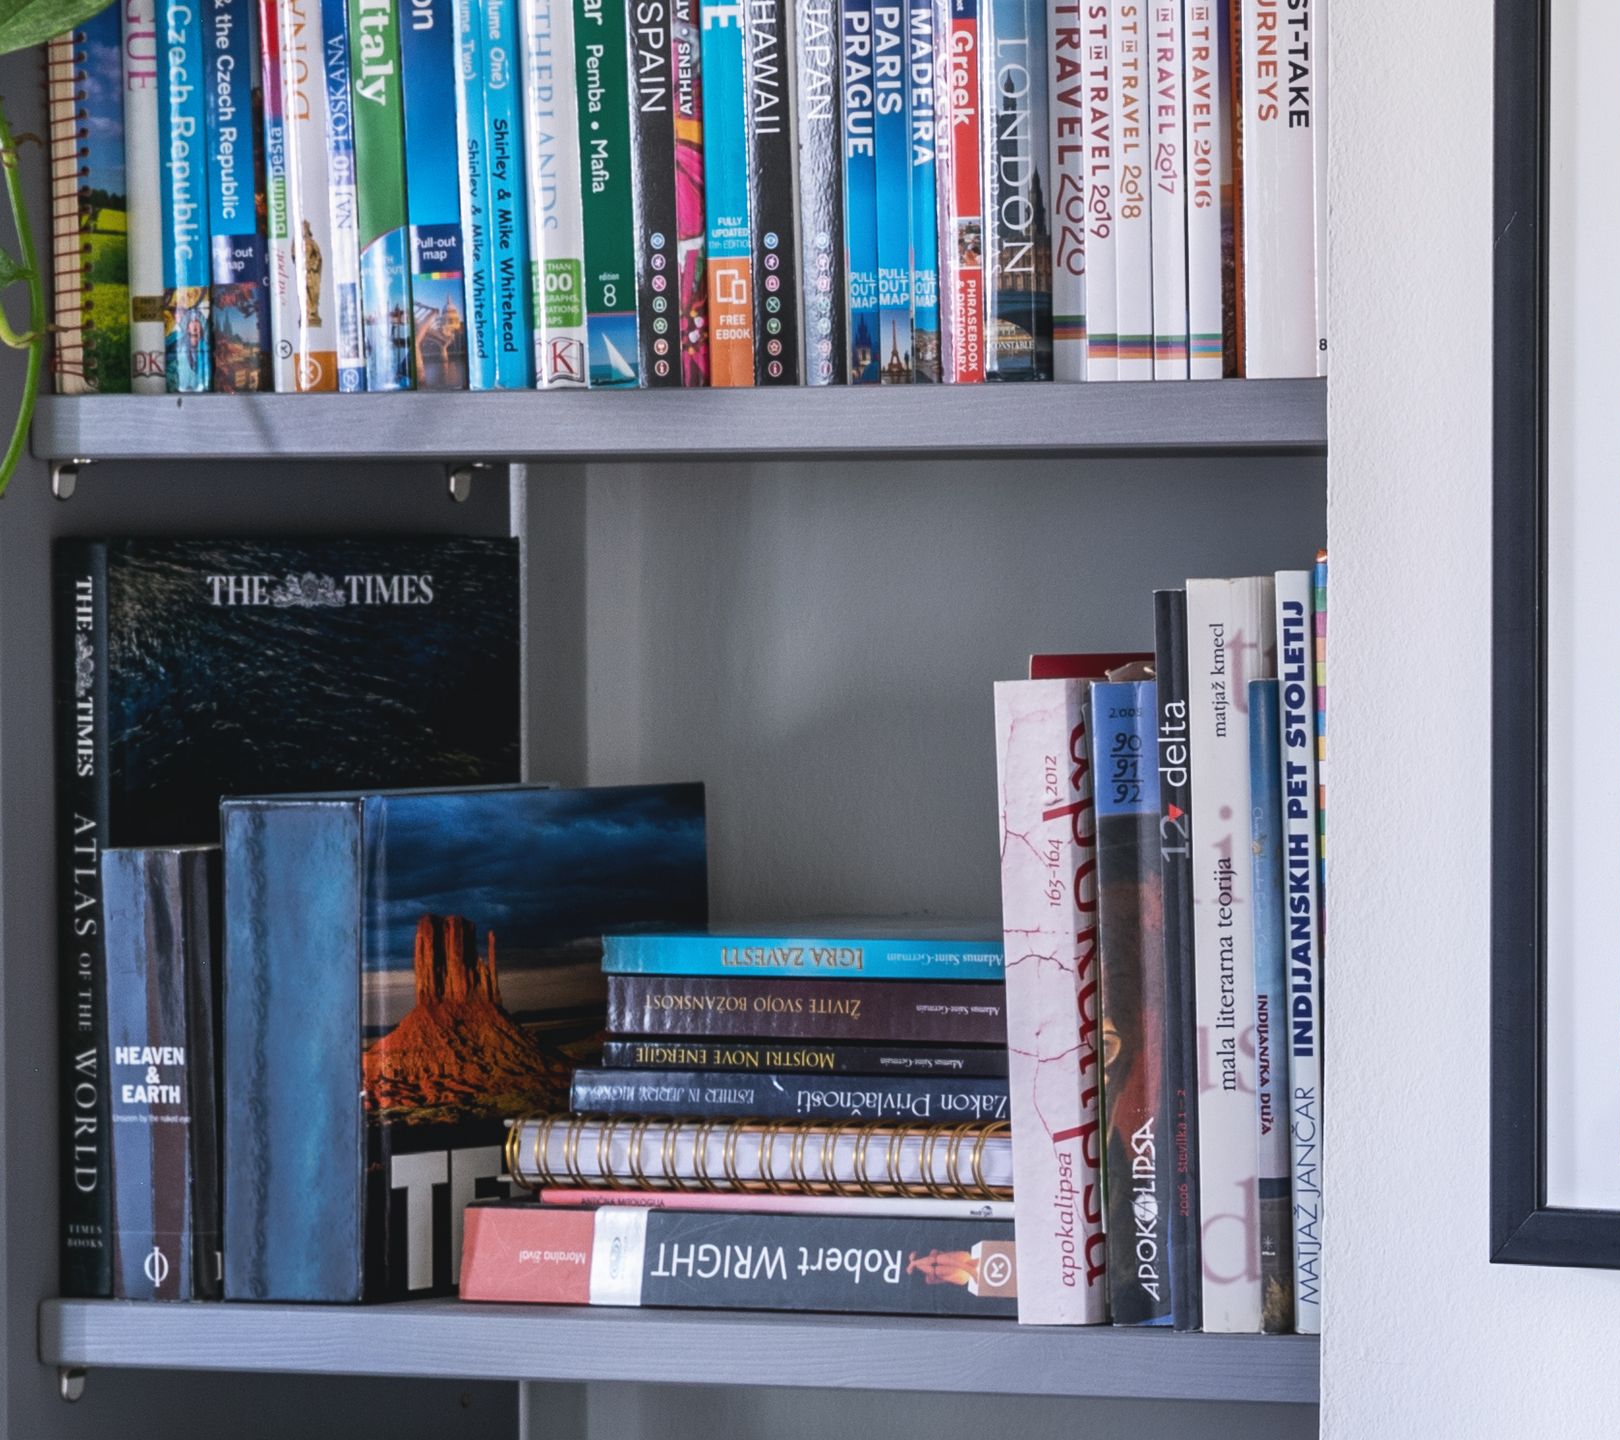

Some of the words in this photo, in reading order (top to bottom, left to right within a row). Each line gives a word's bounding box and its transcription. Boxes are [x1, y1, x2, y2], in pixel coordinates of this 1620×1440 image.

[637, 3, 666, 113] SPAIN
[845, 11, 873, 158] PRAGUE
[875, 7, 902, 115] PARIS
[911, 9, 934, 166] MADEIRA
[951, 30, 975, 125] Greek
[207, 574, 270, 606] THE
[345, 573, 434, 606] TIMES
[1282, 601, 1307, 749] STOLETIJ
[1158, 700, 1187, 787] delta
[1286, 761, 1308, 819] PET
[1288, 834, 1313, 1057] INDIJANSKIH
[115, 1046, 185, 1065] HEAVEN
[122, 1083, 181, 1105] EARTH
[651, 1242, 788, 1280] WRIGHT
[799, 1248, 902, 1283] Robert
